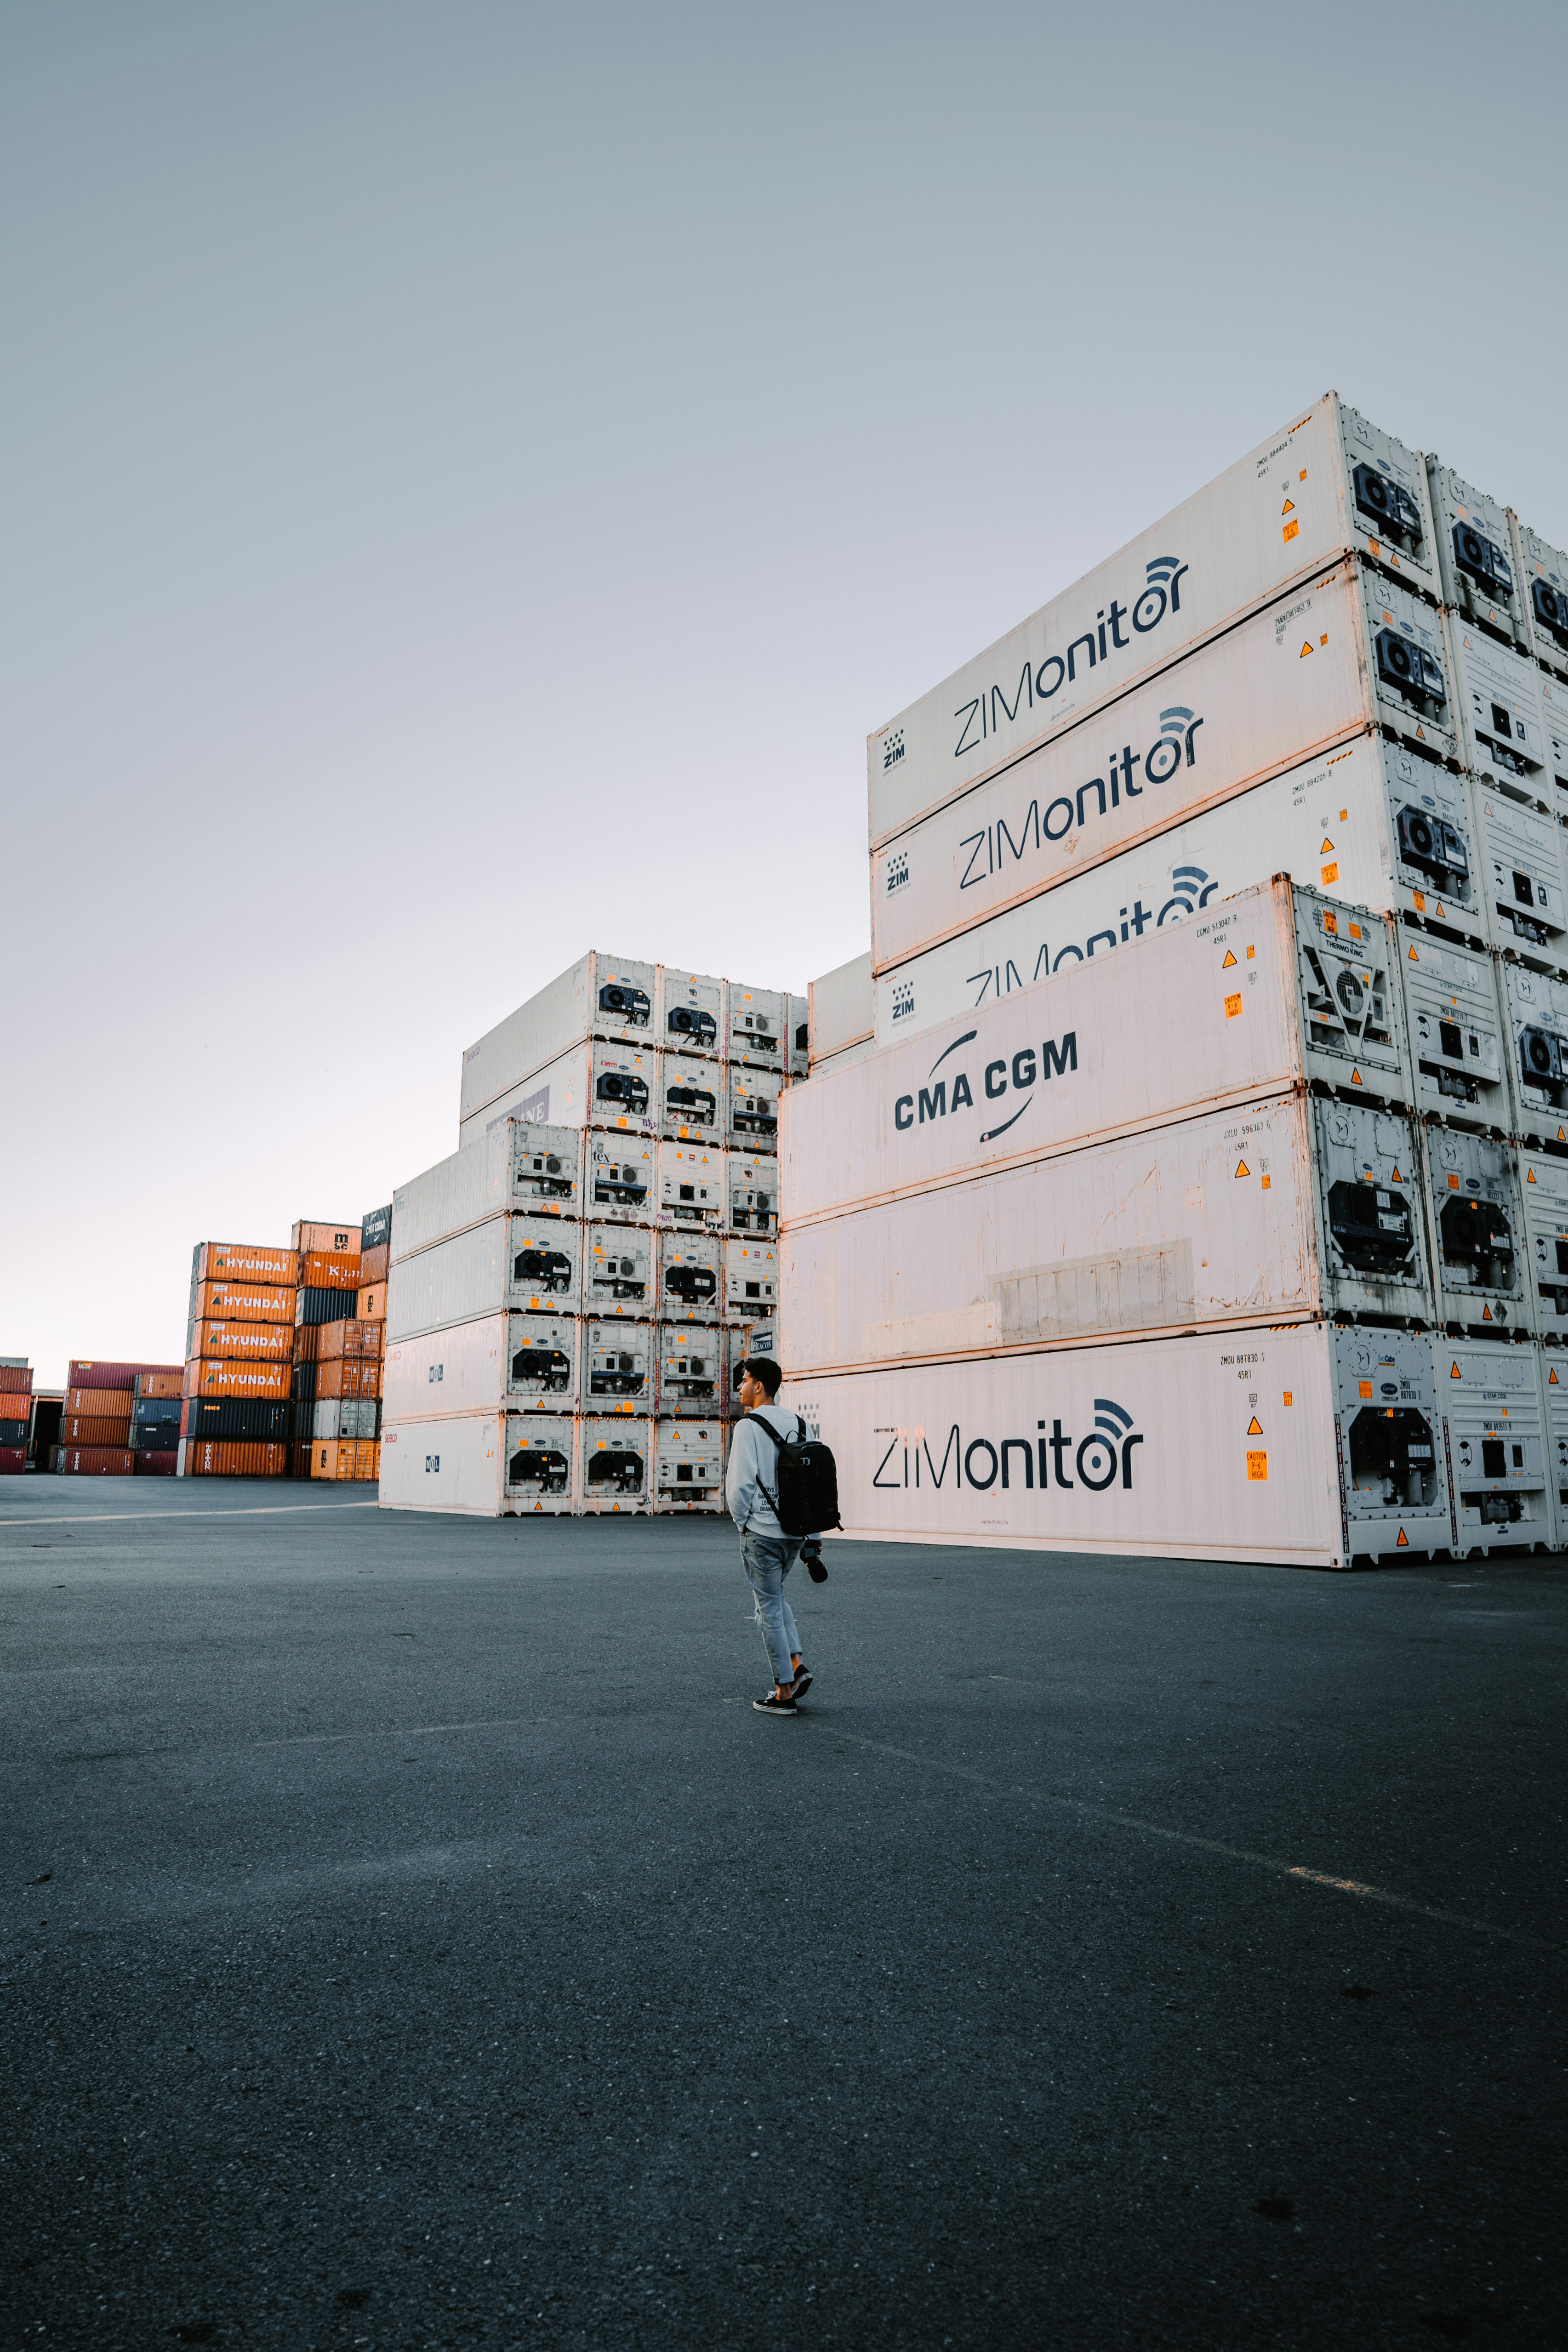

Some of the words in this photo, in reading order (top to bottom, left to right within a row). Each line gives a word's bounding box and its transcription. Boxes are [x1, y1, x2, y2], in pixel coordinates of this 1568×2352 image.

[1256, 456, 1268, 468] ZMOU
[1270, 441, 1288, 459] 884404
[1257, 467, 1269, 478] 45R1
[1283, 519, 1297, 532] CAUTION
[1275, 615, 1287, 626] ZMOU
[1288, 604, 1305, 618] 881453
[1276, 625, 1287, 634] 45R1
[954, 561, 1189, 757] ZIMonitor
[884, 744, 904, 769] ZIM
[1292, 784, 1305, 795] ZMOU
[1307, 774, 1326, 787] 884205
[960, 710, 1203, 889] ZIMonitor
[1293, 796, 1306, 806] 45R1
[1322, 862, 1337, 873] CAUTION
[887, 868, 908, 891] ZIM
[1326, 875, 1335, 884] HIGH
[1197, 926, 1210, 937] CGMU
[1212, 917, 1231, 932] 513047
[1233, 915, 1237, 923] 9
[1214, 934, 1226, 945] 45R1
[1326, 940, 1349, 953] THERMO
[1350, 948, 1363, 958] KING
[1225, 993, 1241, 1004] CAUTION
[892, 997, 914, 1020] ZIM
[1229, 1008, 1238, 1017] HIGH
[467, 1047, 480, 1063] seaco
[895, 1073, 974, 1131] CMA
[985, 1031, 1078, 1099] CGM
[593, 1150, 610, 1162] tex
[226, 1258, 286, 1272] HYUNDAI
[224, 1296, 285, 1310] HYUNDAI
[221, 1335, 282, 1347] HYUNDAI
[1220, 1356, 1234, 1365] ZMOU
[1237, 1353, 1258, 1364] 887830
[430, 1368, 442, 1379] MOL
[1238, 1370, 1251, 1379] 45R1
[218, 1374, 280, 1386] HYUNDAI
[1400, 1380, 1410, 1390] ZMOU
[1401, 1390, 1416, 1400] 887830
[1494, 1423, 1507, 1431] 893511
[385, 1433, 397, 1443] seaco
[872, 1413, 1144, 1491] ZIMonitor
[426, 1459, 439, 1469] MOL
